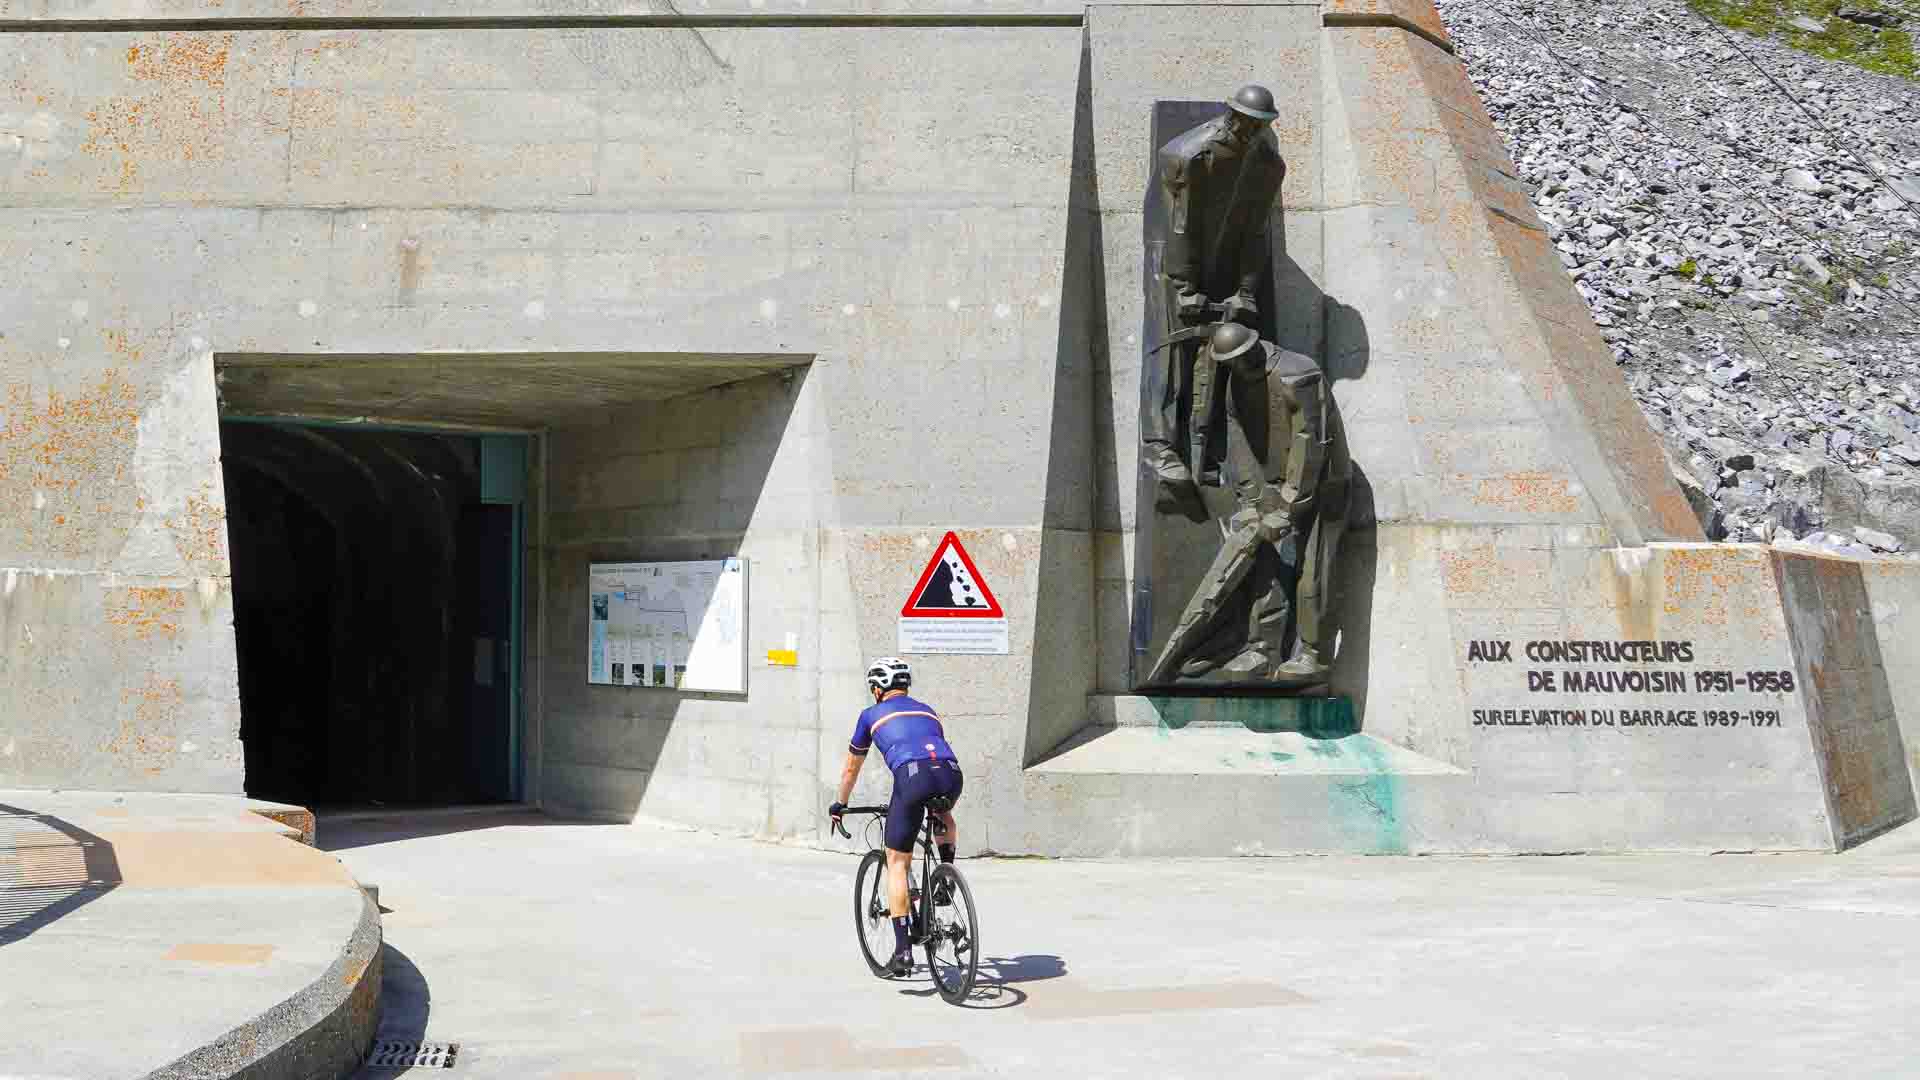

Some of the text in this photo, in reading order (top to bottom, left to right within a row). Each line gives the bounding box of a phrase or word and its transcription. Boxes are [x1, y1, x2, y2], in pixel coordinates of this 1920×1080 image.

[1468, 640, 1693, 662] AUX CONSTRUCTEURS
[1527, 670, 1795, 692] DE MAUVOISIN 1951-1958
[1472, 709, 1781, 728] SURELEVATION DU BARRAGE 1989-1991
